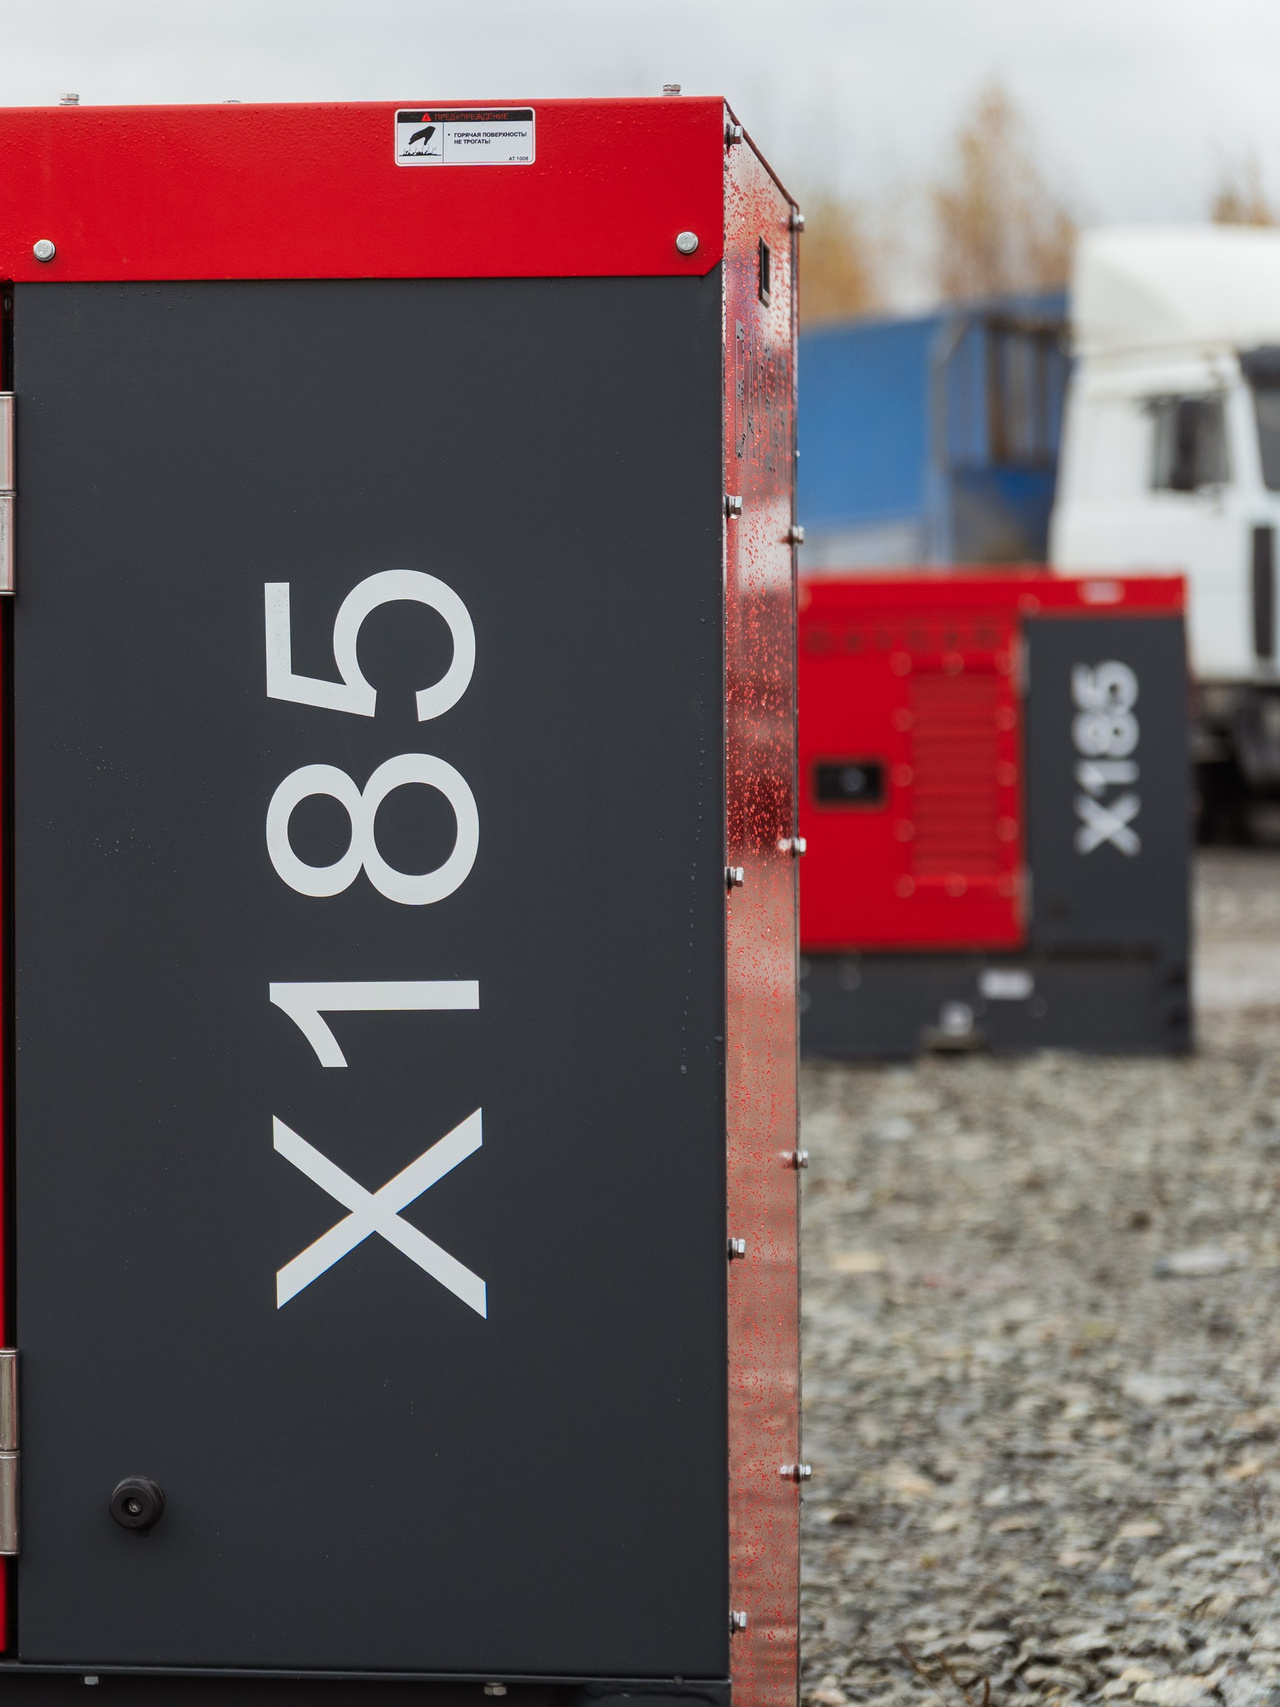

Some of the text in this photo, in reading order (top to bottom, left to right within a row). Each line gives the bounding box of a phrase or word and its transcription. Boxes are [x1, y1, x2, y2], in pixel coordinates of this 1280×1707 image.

[434, 112, 509, 121] ПРЕДУПРЕЖДЕНИЕ
[1071, 659, 1141, 858] X185
[265, 568, 488, 1320] X185
